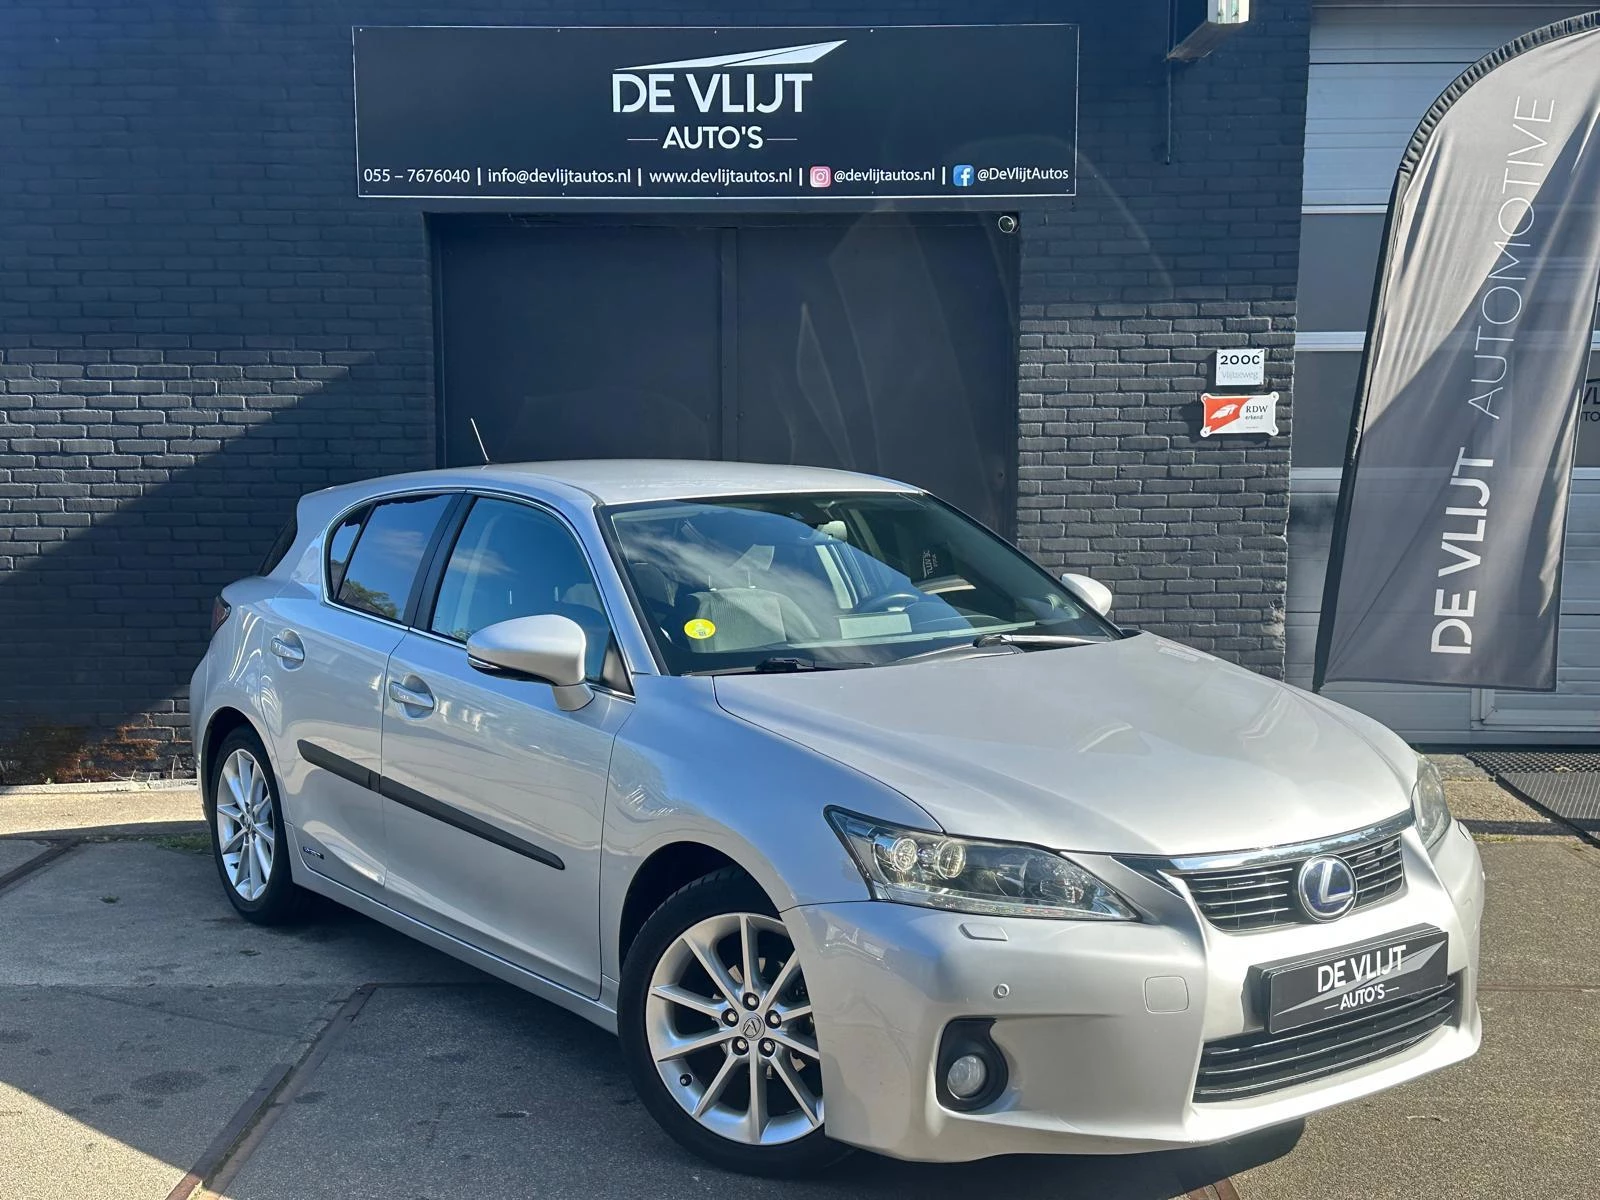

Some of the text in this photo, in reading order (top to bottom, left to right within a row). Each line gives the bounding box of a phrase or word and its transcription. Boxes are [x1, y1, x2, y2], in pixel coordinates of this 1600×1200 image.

[612, 73, 813, 113] DE VLIJT
[662, 125, 764, 150] AUTO'S
[363, 168, 391, 183] 055
[406, 168, 471, 183] 7676040
[487, 167, 631, 187] info@devlijtautos.nl
[648, 167, 792, 187] www.devlijtautos.nl
[833, 167, 935, 187] @devlijtautos.nl
[977, 167, 1069, 186] @DeVlijtAutos
[1430, 95, 1555, 655] DE VLIJT AUTOMOTIVE
[1246, 405, 1268, 413] RDW
[1317, 944, 1407, 993] DE VLIJT
[1339, 983, 1385, 1010] AUTO'S
